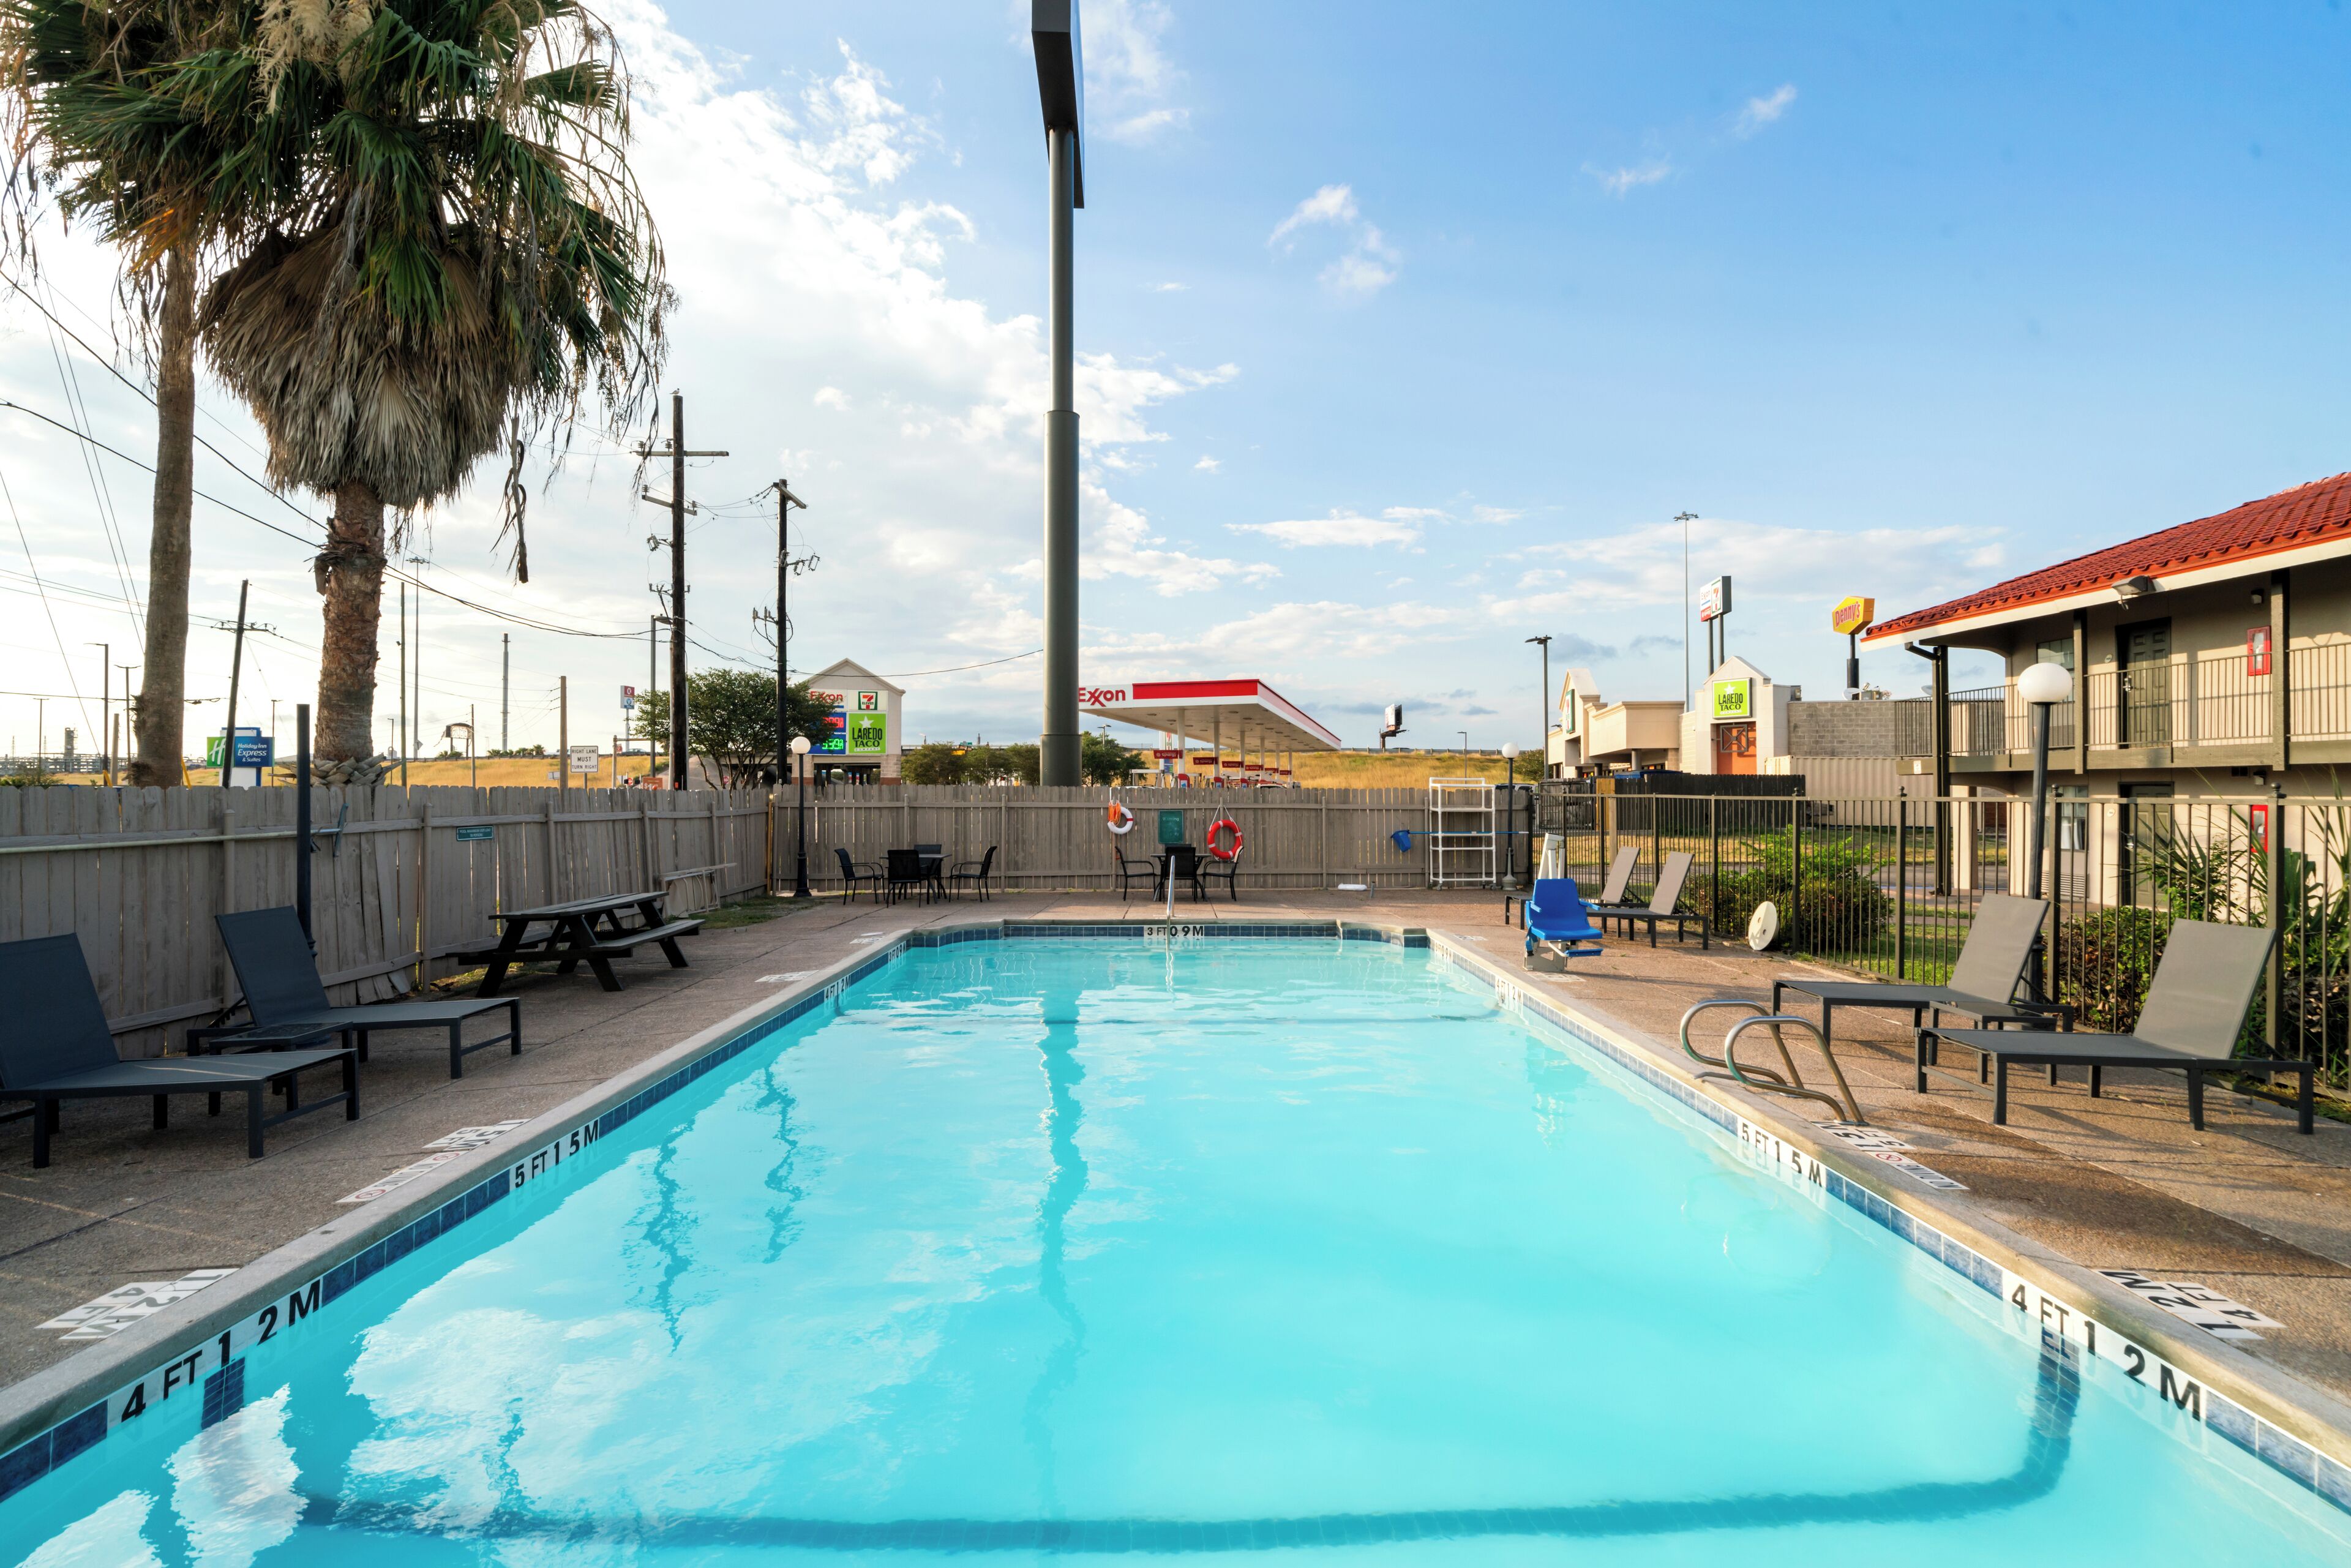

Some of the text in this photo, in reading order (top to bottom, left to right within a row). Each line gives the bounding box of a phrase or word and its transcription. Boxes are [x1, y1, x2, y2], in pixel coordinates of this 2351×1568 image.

[1835, 601, 1861, 628] Denny's
[1079, 687, 1125, 707] Exxon
[1718, 692, 1743, 705] LAREDO
[852, 727, 882, 740] LAREDO
[238, 749, 267, 757] Express
[1147, 927, 1153, 936] 3
[1157, 927, 1167, 936] FT
[515, 1163, 525, 1188] 5
[532, 1150, 547, 1179] FT
[584, 1119, 598, 1148] M
[1742, 1122, 1749, 1142] 5
[1755, 1130, 1769, 1153] FT
[1809, 1160, 1822, 1187] M
[121, 1382, 146, 1422] 4
[163, 1349, 203, 1401] FT
[288, 1279, 320, 1327] M
[2012, 1284, 2027, 1313] 4
[2040, 1296, 2069, 1336] FT
[2160, 1363, 2201, 1421] M
